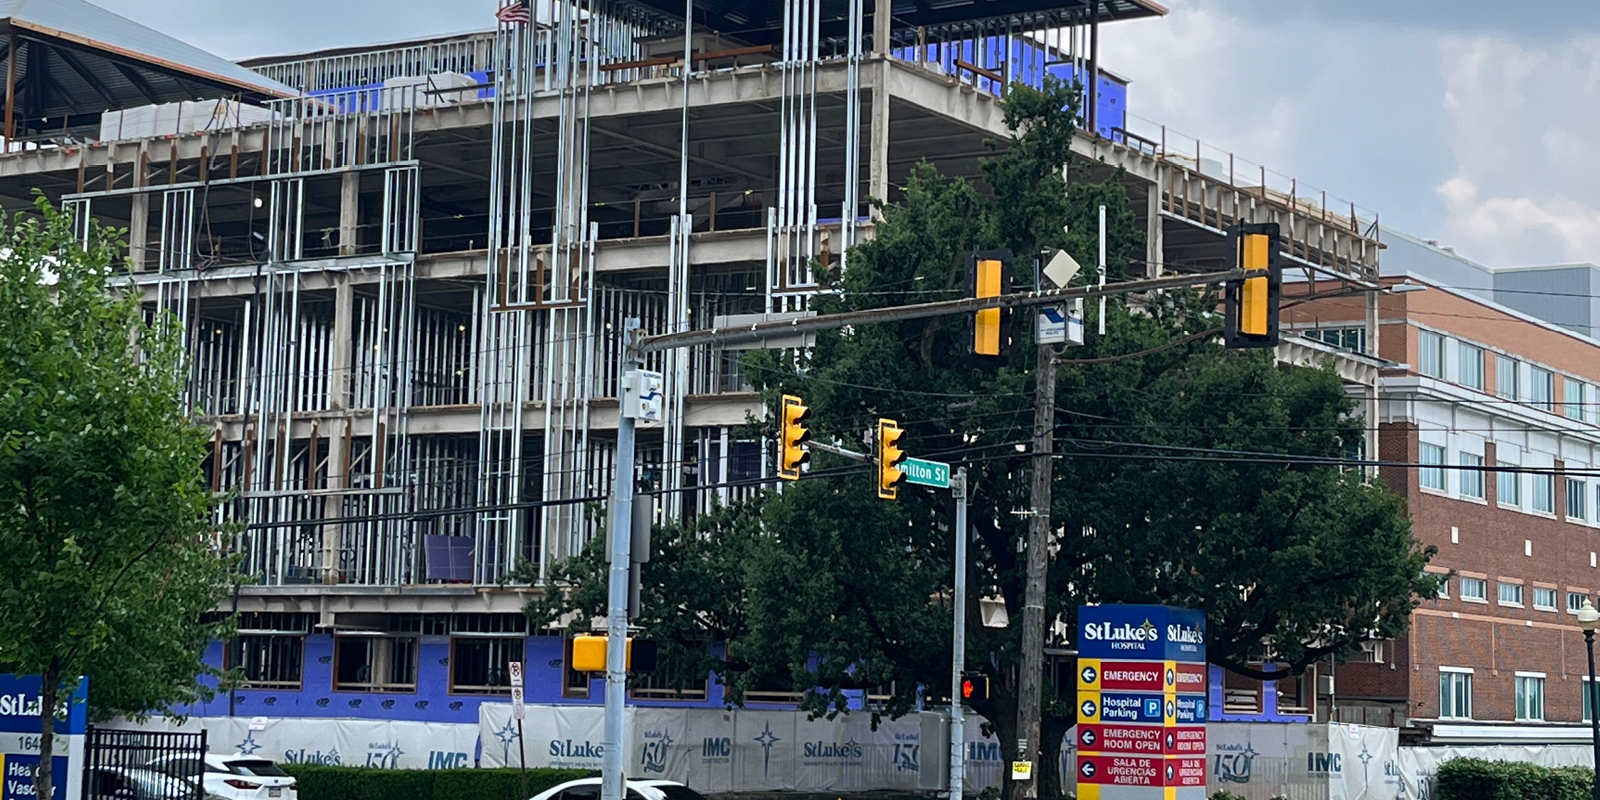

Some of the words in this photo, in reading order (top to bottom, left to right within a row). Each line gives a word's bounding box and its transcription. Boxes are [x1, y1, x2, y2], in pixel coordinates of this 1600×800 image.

[895, 463, 931, 480] amilton
[935, 467, 946, 482] St
[1111, 642, 1145, 650] HOSPITAL
[1104, 671, 1158, 682] EMERGENCY
[1103, 697, 1141, 709] Hospital
[1103, 707, 1138, 720] Parking
[1103, 729, 1161, 739] EMERGENCY
[702, 737, 731, 757] IMC
[970, 741, 1003, 760] IM
[1103, 740, 1132, 749] ROOM
[1136, 741, 1161, 750] OPEN
[428, 750, 467, 769] IMC
[1214, 753, 1251, 775] 150
[1308, 752, 1342, 772] IMC
[1107, 767, 1156, 776] URGENCIAS
[1114, 776, 1151, 785] ABIERTA
